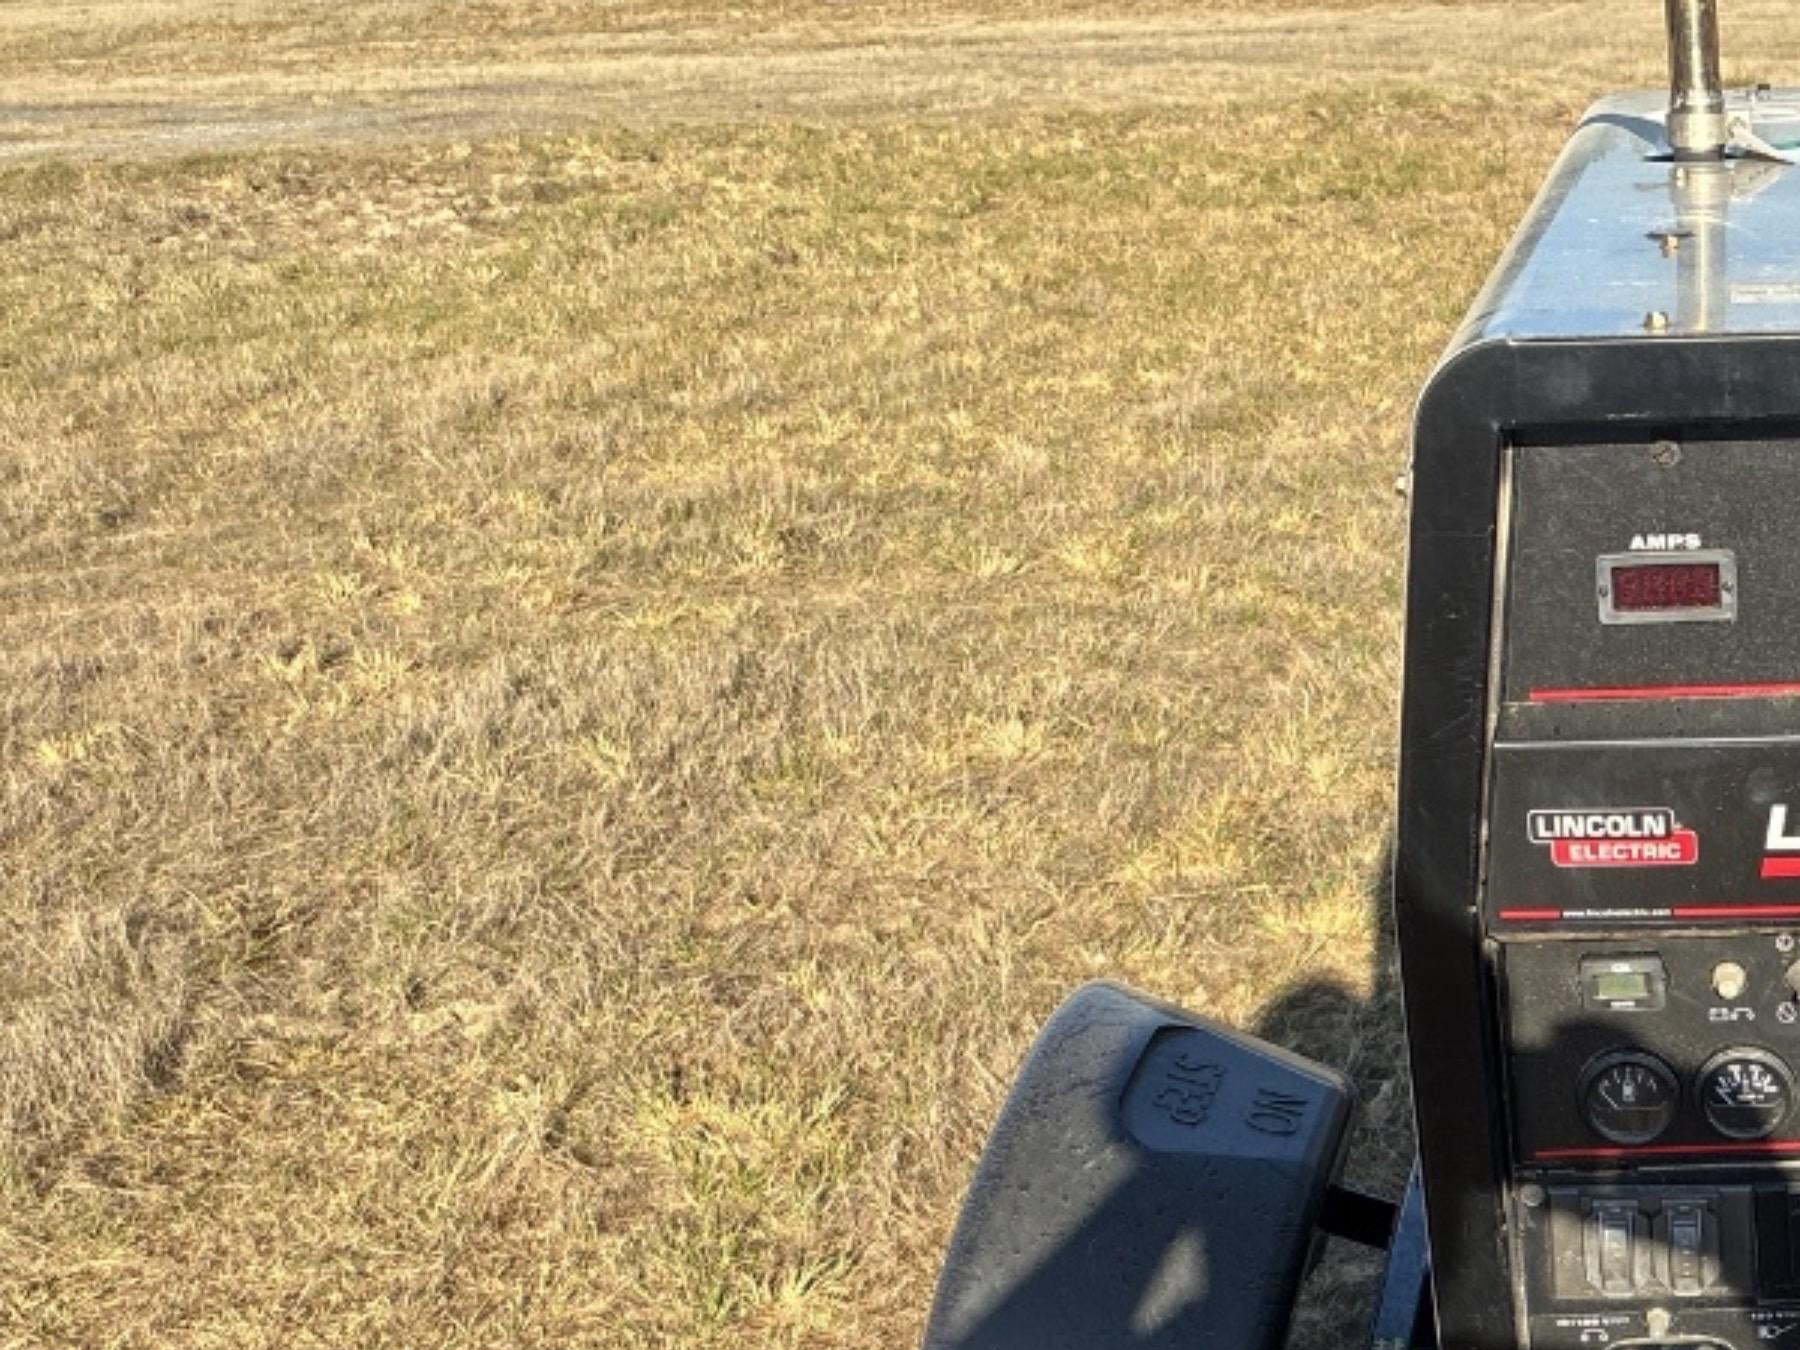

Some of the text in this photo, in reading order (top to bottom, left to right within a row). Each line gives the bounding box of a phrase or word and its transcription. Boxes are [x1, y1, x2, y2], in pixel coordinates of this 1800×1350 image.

[1629, 534, 1702, 550] AMPS
[1535, 814, 1667, 839] LINCOLN
[1568, 842, 1682, 862] ELECTRIC
